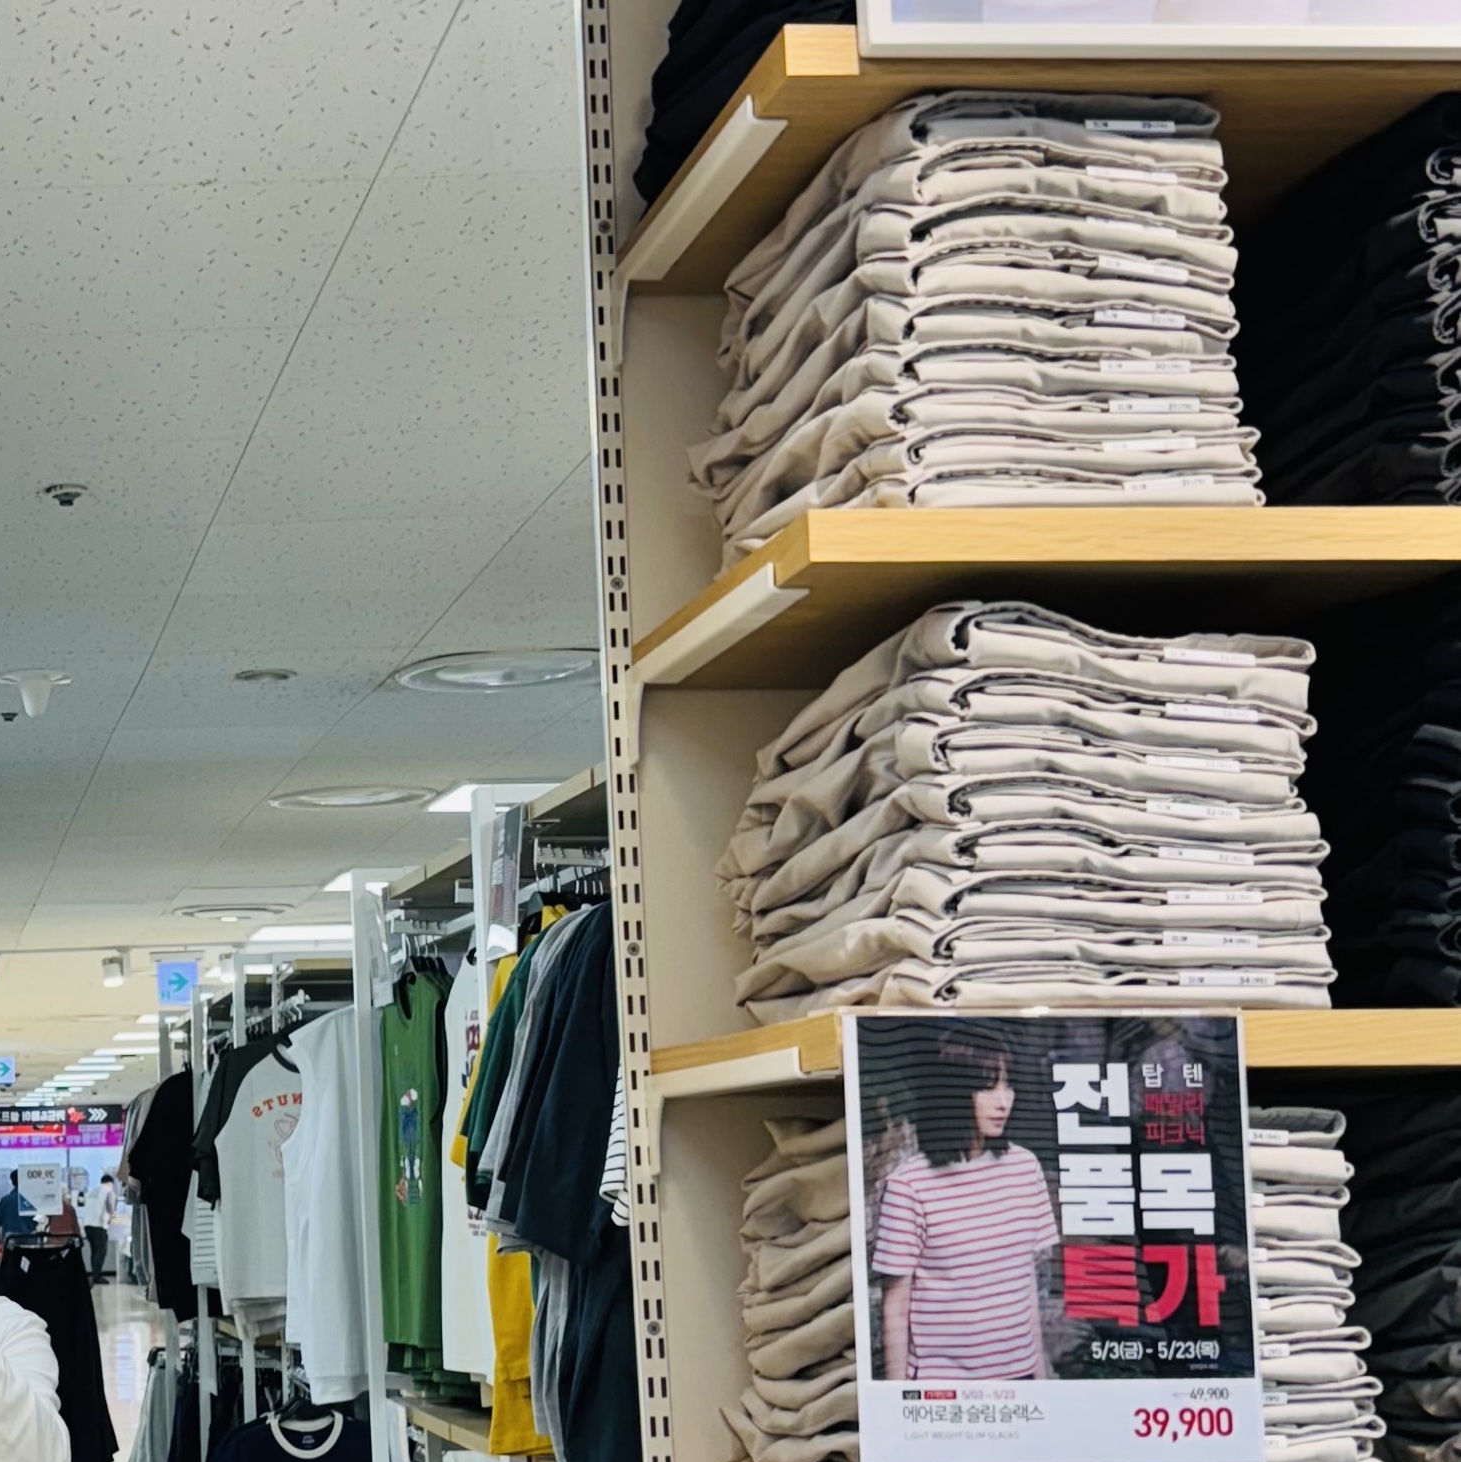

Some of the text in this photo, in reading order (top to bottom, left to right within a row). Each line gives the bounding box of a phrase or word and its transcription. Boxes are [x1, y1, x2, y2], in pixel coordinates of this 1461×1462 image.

[1145, 1122, 1205, 1146] 피크닉
[1062, 1243, 1227, 1327] 특가
[1091, 1340, 1144, 1361] 5/3(금)
[1157, 1339, 1220, 1361] 5/23(목)
[1189, 1387, 1230, 1402] 49,900
[902, 1404, 1045, 1423] 에어로쿨 슬림 슬랙스
[1134, 1406, 1234, 1443] 39,900
